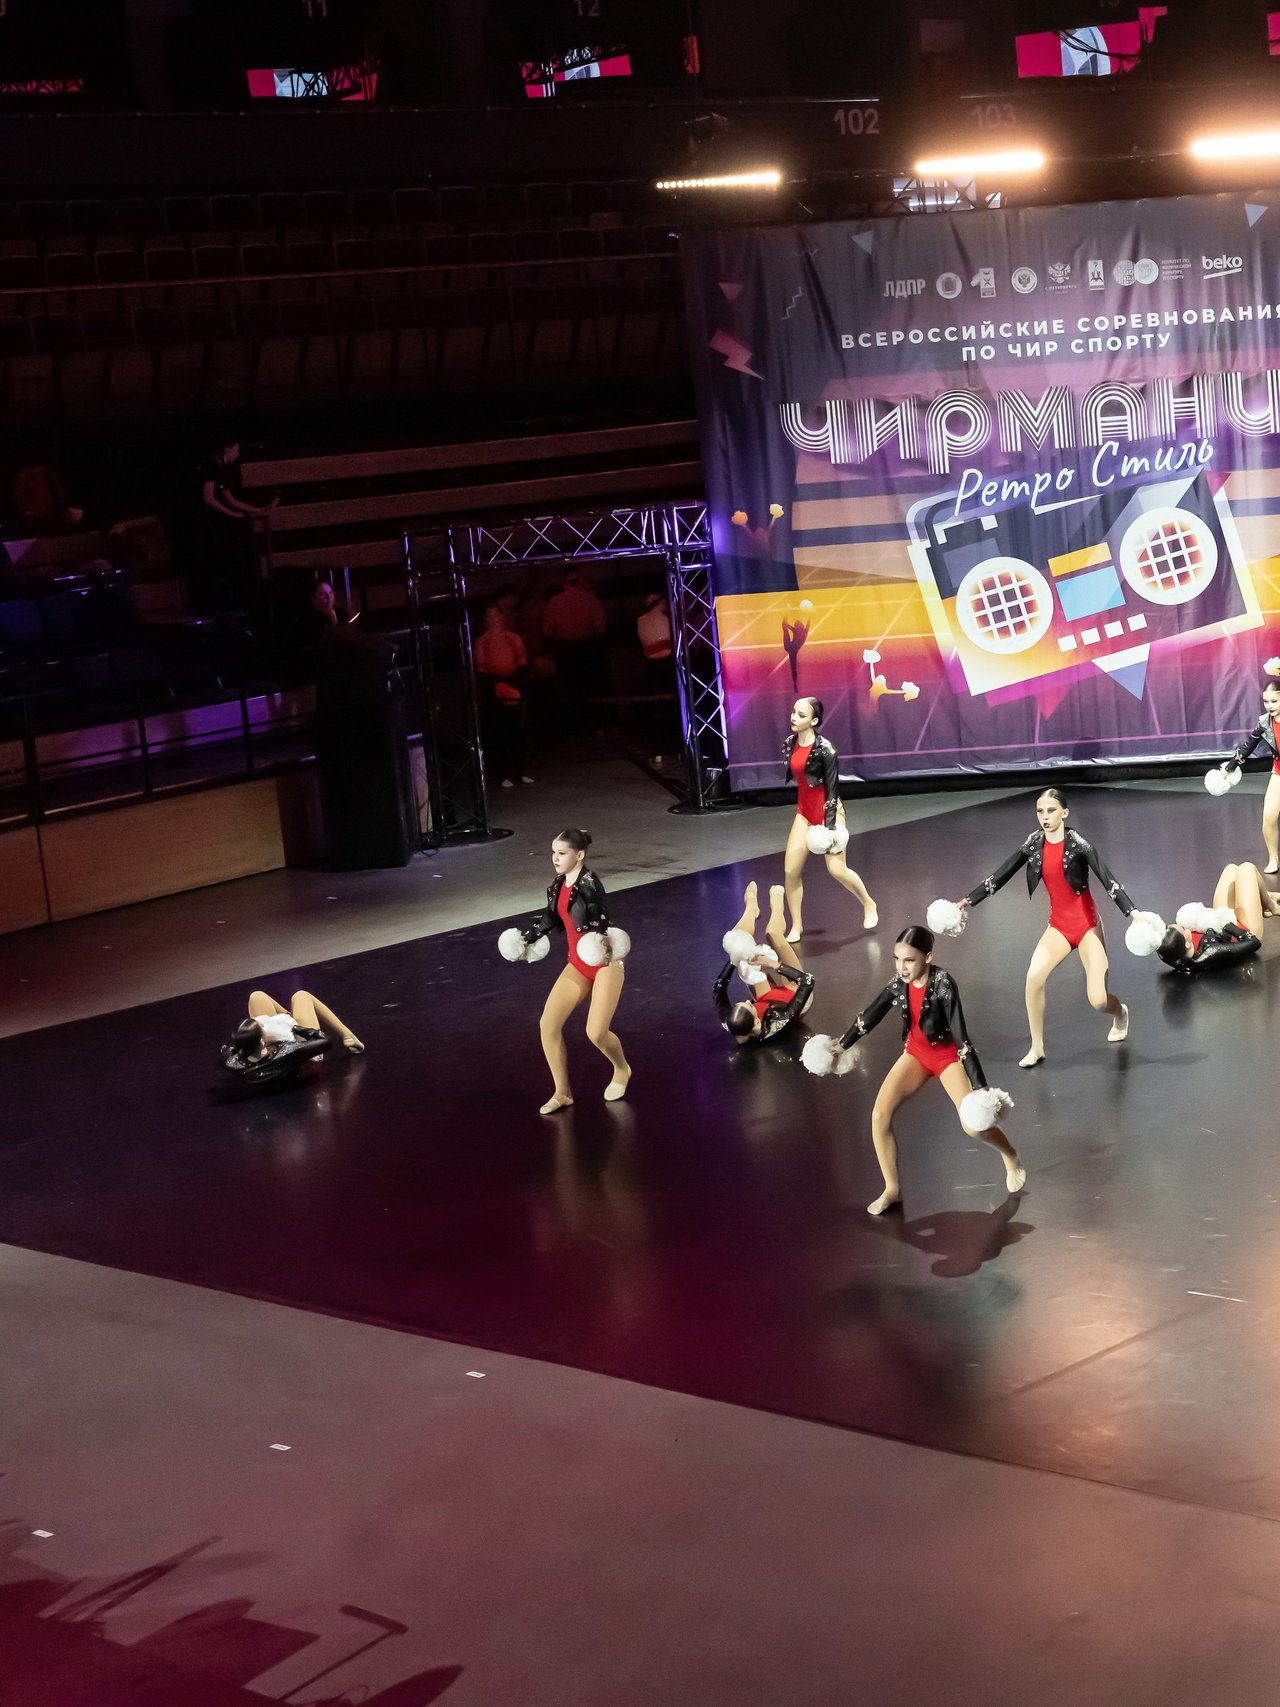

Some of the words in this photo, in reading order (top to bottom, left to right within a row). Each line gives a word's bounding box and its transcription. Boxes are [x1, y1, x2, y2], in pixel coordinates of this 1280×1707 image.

[833, 108, 880, 135] 102
[1202, 254, 1243, 270] beko
[883, 279, 926, 299] ЛДПР
[841, 318, 1066, 350] ВСЕРОССИЙСКИЕ
[962, 346, 996, 362] ПО
[1008, 341, 1059, 358] ЧИР
[1071, 333, 1172, 355] СПОРТУ
[954, 467, 1075, 516] Ретро
[1091, 439, 1215, 488] Стиль
